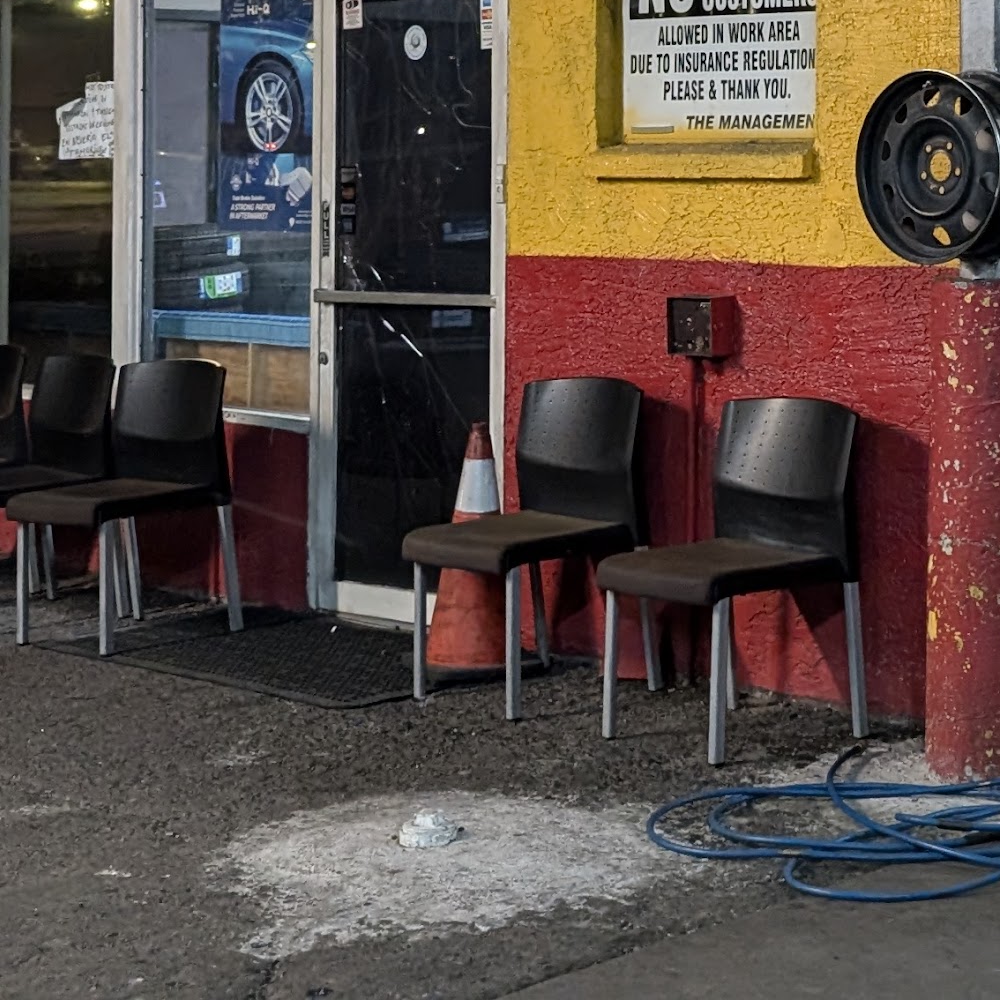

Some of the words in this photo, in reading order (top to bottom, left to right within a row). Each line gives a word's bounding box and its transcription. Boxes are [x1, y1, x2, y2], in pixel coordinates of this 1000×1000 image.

[657, 23, 708, 46] ALLOWED
[712, 23, 724, 44] IN
[728, 21, 765, 43] WORK
[768, 20, 800, 41] AREA
[630, 54, 652, 75] DUE
[656, 53, 670, 74] TO
[674, 51, 739, 73] INSURANCE
[743, 48, 816, 71] REGULATION
[663, 80, 704, 101] PLEASE
[708, 81, 717, 99] &
[721, 78, 760, 100] THANK
[763, 78, 791, 99] YOU.
[686, 115, 714, 130] THE
